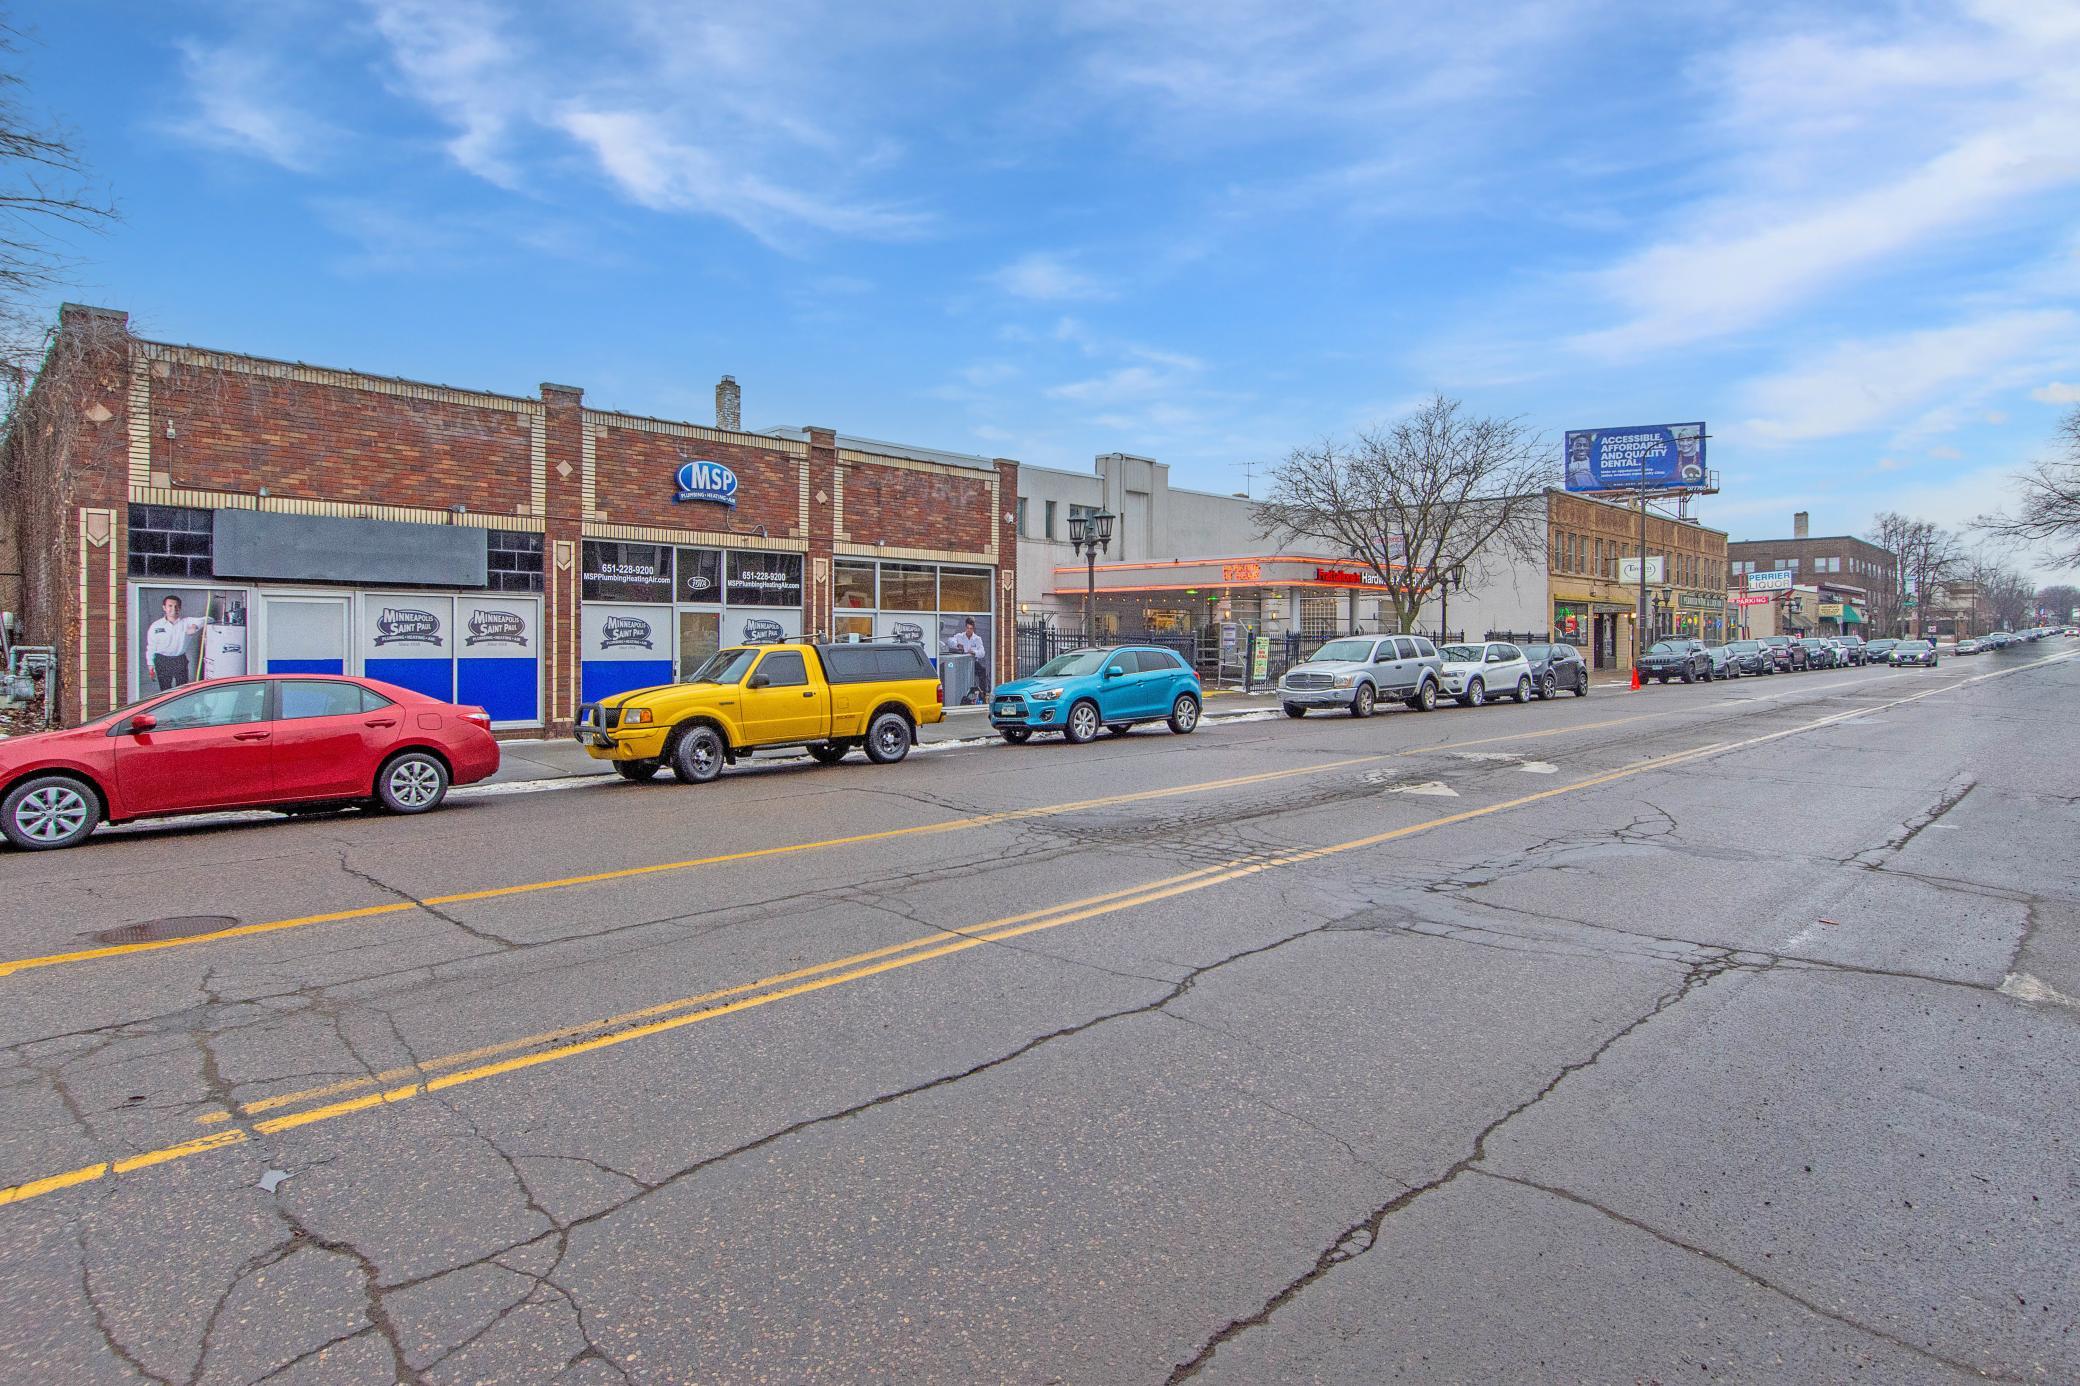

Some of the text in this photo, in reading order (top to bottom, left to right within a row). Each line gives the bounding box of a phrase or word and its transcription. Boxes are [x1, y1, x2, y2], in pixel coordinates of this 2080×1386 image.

[1601, 433, 1663, 444] ACCESSIBLE,
[1601, 441, 1667, 452] AFFORDABLE,
[1601, 449, 1668, 460] AND QUALITY
[1601, 459, 1641, 468] DENTAL.
[691, 462, 733, 490] MSP
[602, 563, 654, 575] 651-228-9200
[583, 572, 671, 584] MSPPlumbingHeatingAir.com
[742, 571, 786, 581] 651-228-9200
[1749, 572, 1790, 581] PERRIER
[727, 580, 800, 589] MSPPlumbingHeatingAir.com
[1750, 580, 1790, 589] LIQUOR
[383, 608, 434, 622] MINNEAPOLIS
[474, 610, 520, 624] MINNEAPOLIS
[608, 616, 647, 629] MINNEAPOLIS
[747, 619, 780, 630] MINNEAPOLIS
[390, 623, 431, 636] SAINT PAUL
[480, 624, 517, 636] SAINT PAUL
[612, 629, 632, 640] SAINT
[751, 630, 768, 641] SAINT
